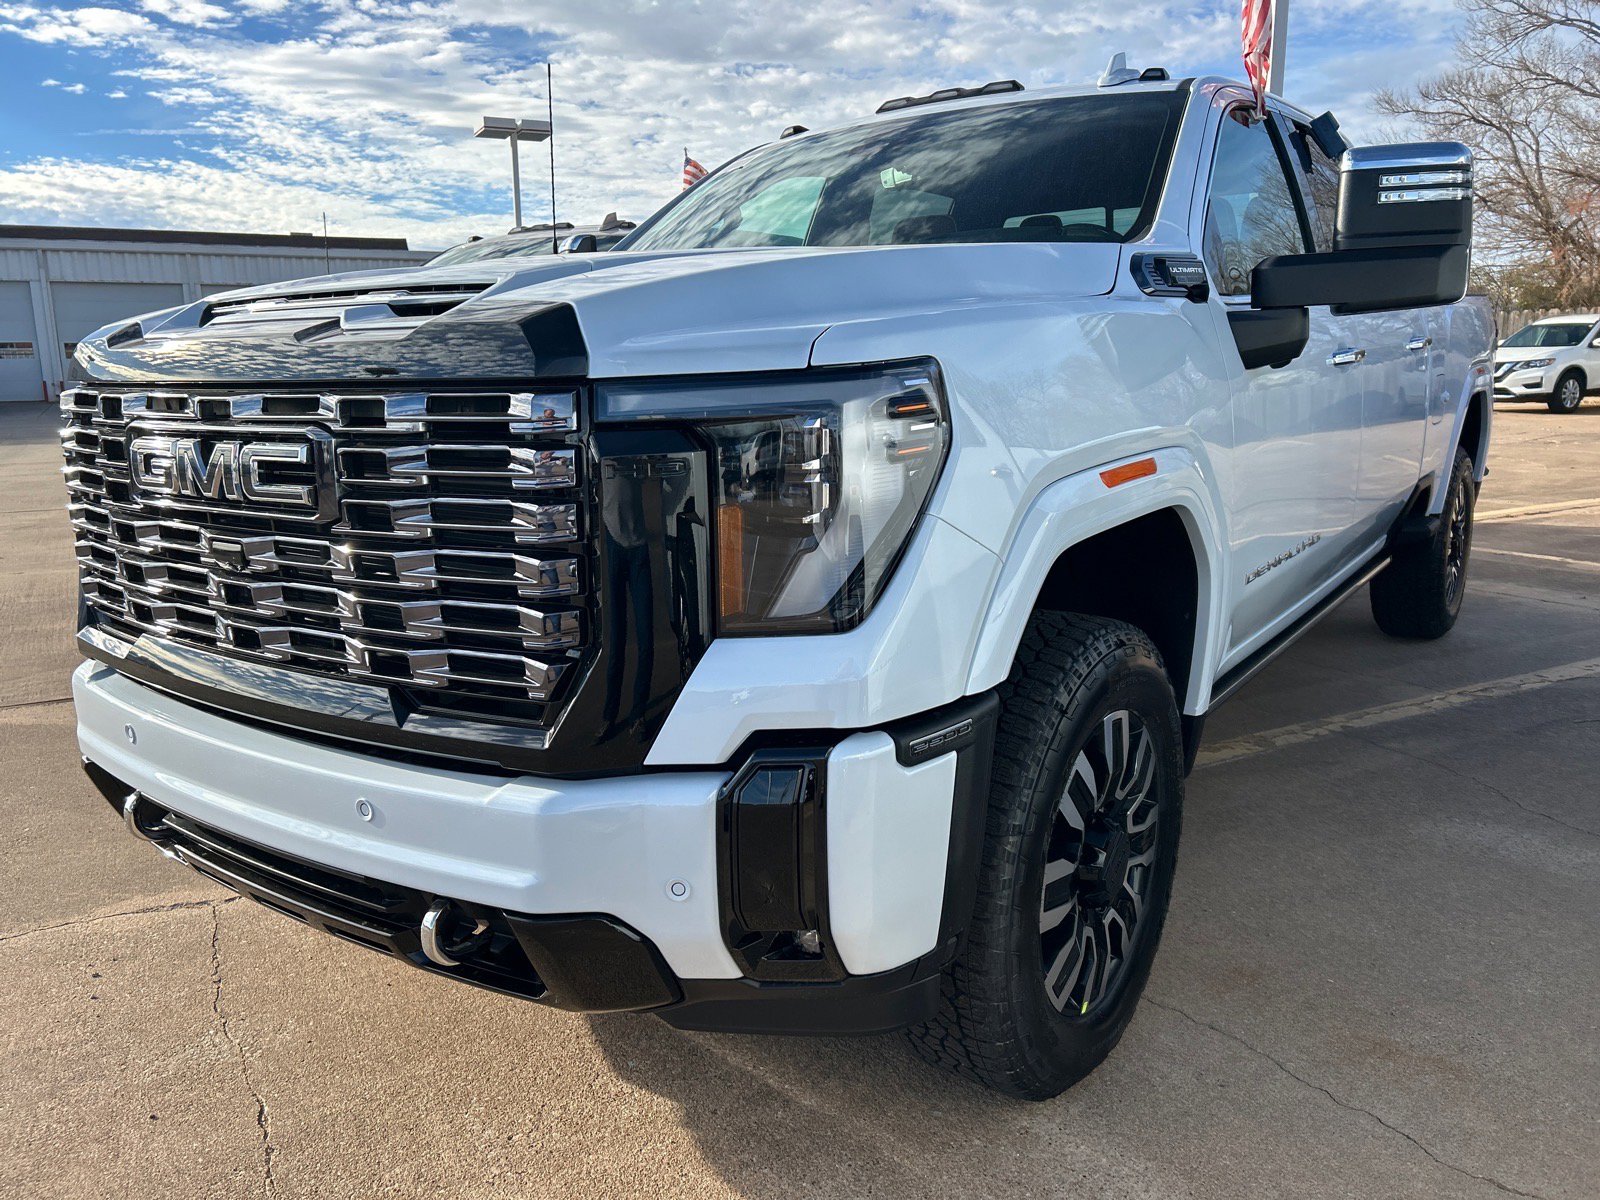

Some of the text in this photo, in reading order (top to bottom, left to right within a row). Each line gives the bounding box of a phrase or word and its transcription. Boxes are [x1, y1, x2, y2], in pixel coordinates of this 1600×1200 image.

[1169, 266, 1203, 274] ULTIMATE
[130, 436, 315, 505] GMC
[1244, 544, 1300, 585] DENALI
